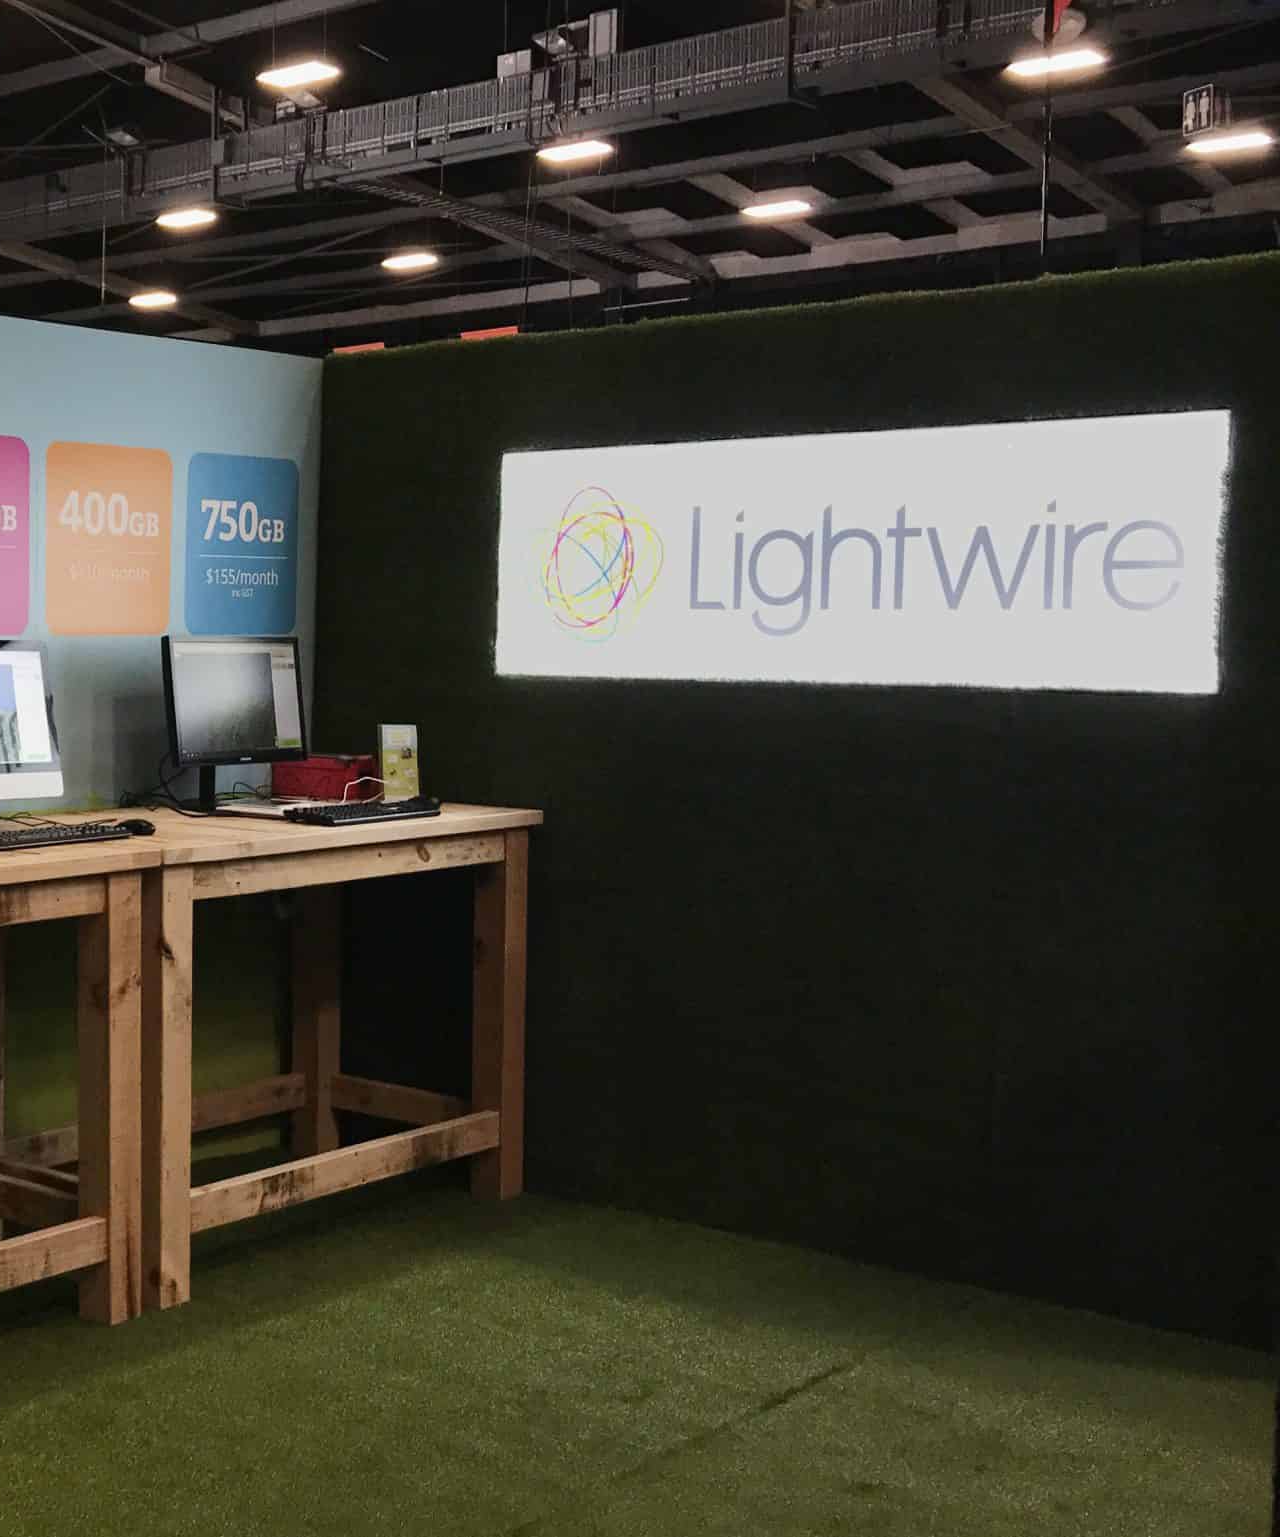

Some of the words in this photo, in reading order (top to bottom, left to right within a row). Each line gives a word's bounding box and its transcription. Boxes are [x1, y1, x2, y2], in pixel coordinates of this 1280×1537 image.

[59, 490, 160, 537] 400GB
[201, 499, 285, 543] 750GB
[206, 567, 279, 585] $155/month
[689, 499, 1185, 636] Lightwire
